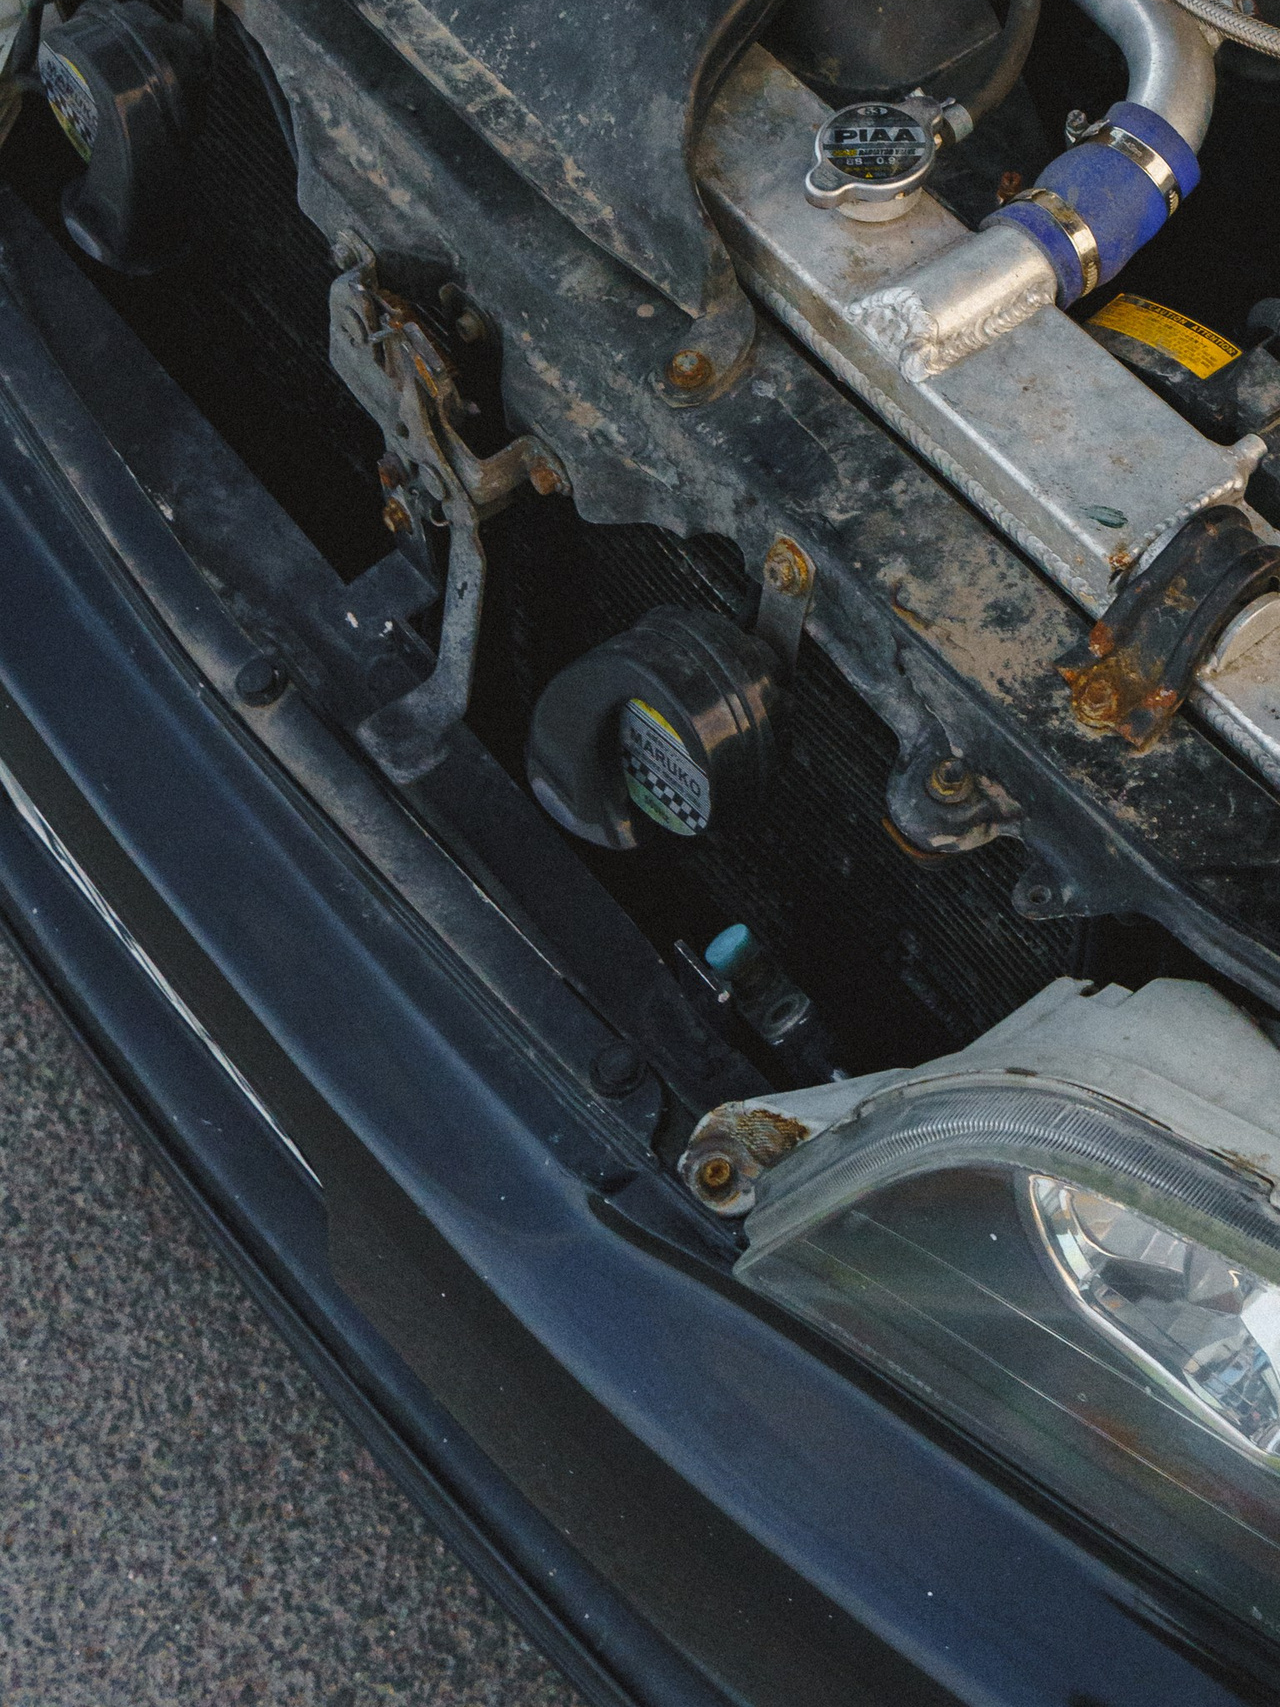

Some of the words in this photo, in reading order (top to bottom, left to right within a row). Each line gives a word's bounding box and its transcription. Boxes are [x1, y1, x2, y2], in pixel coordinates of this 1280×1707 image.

[834, 129, 916, 143] PIAA
[1147, 303, 1189, 326] CAUTION
[1189, 323, 1238, 356] ATTENTION
[634, 732, 702, 798] MARUKO
